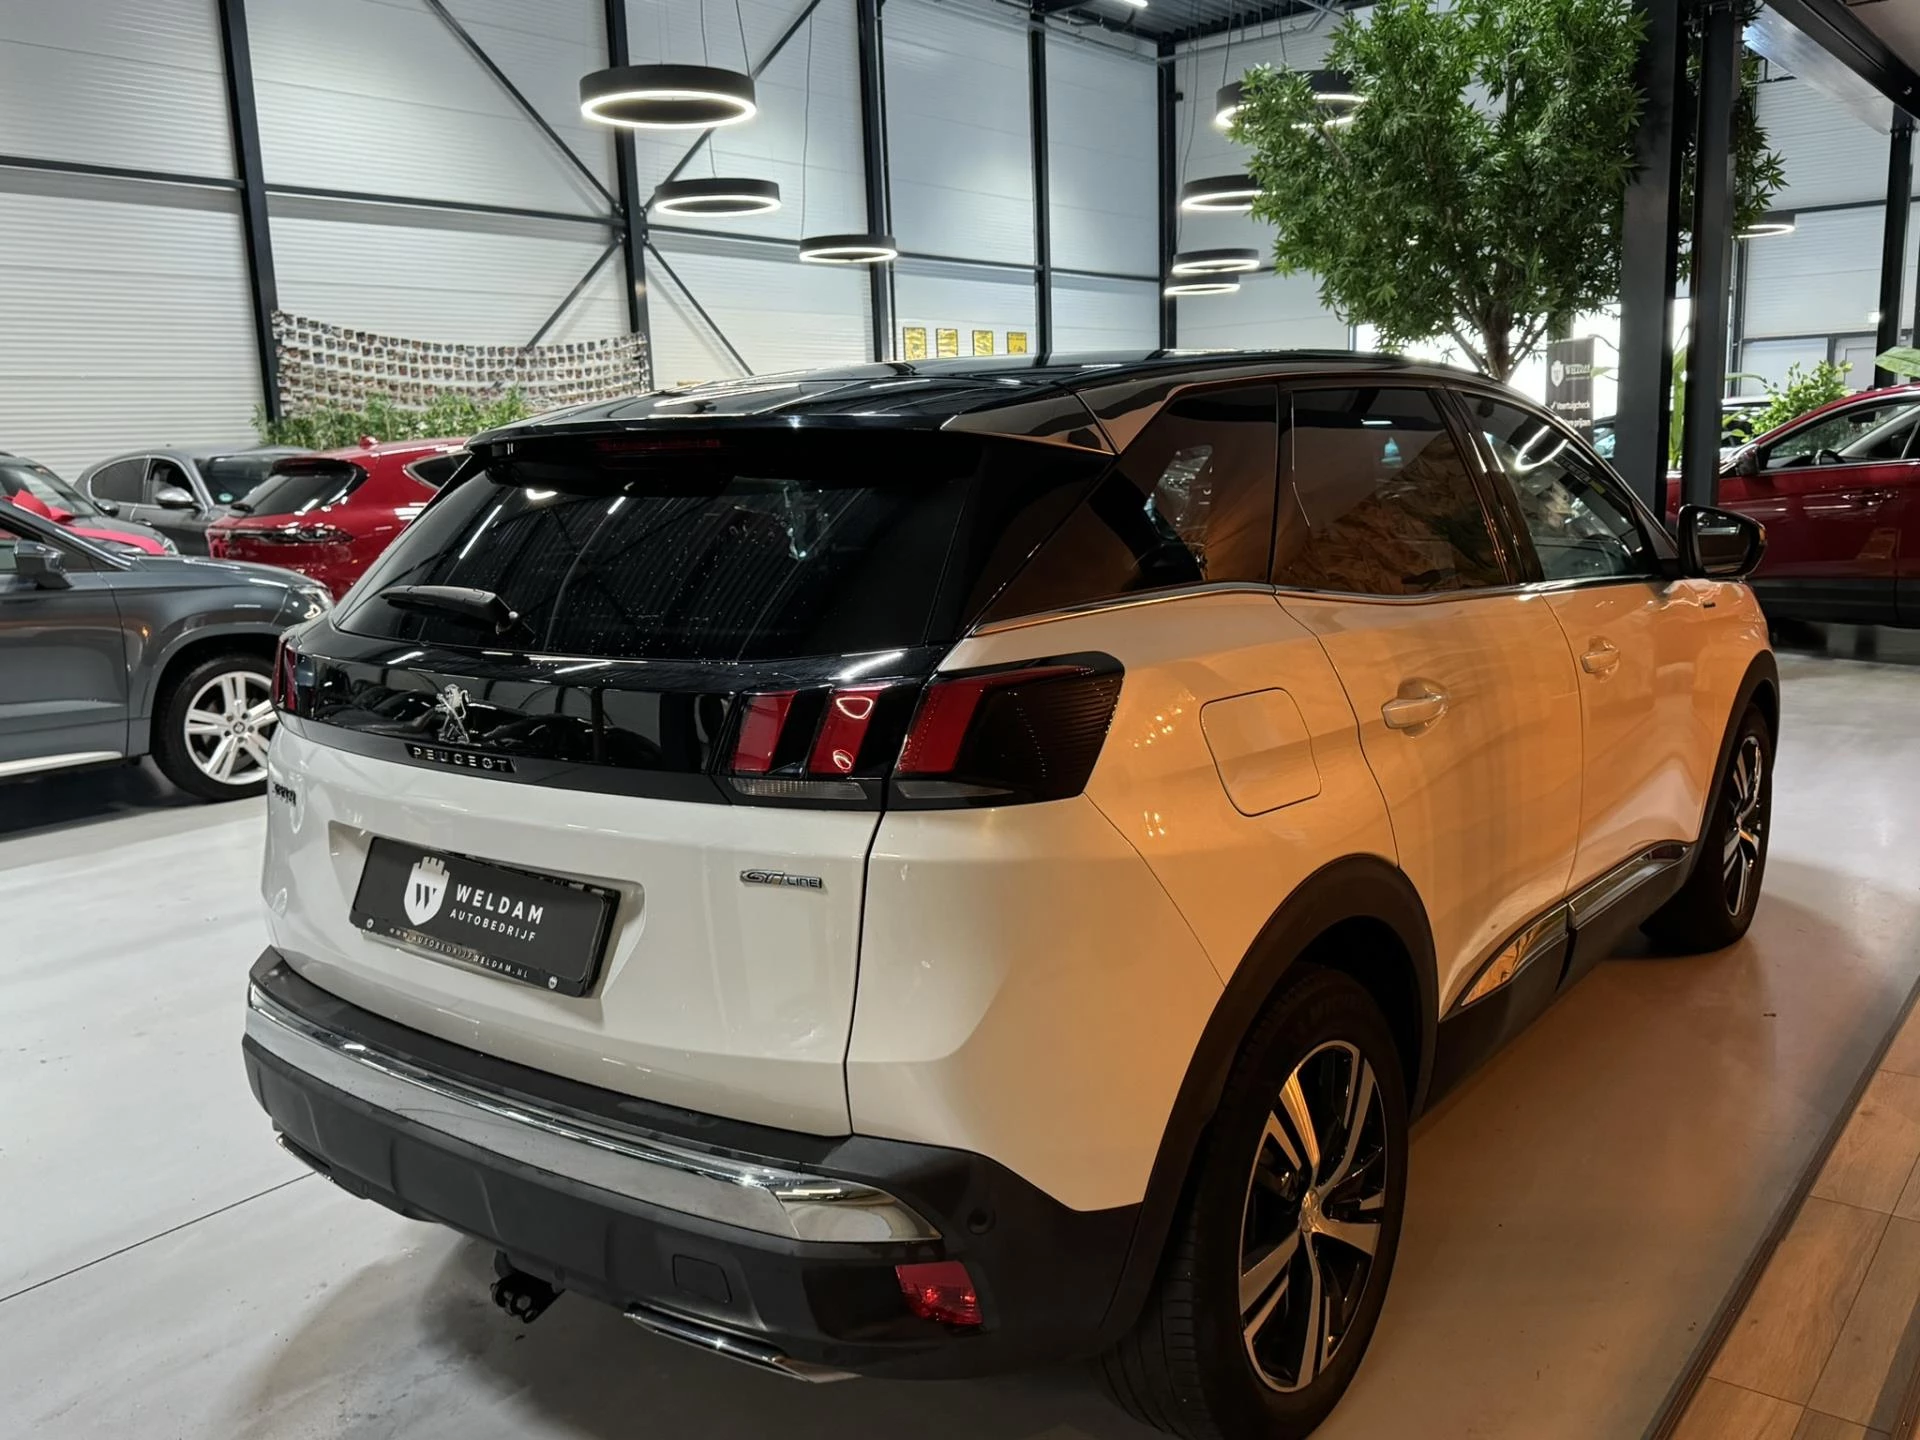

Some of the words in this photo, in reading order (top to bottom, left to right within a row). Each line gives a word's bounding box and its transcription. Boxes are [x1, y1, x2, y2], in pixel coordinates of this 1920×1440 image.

[413, 747, 507, 772] PEUGEOT
[456, 883, 544, 925] WELDAM
[449, 910, 536, 942] AUTOBEDRIJF
